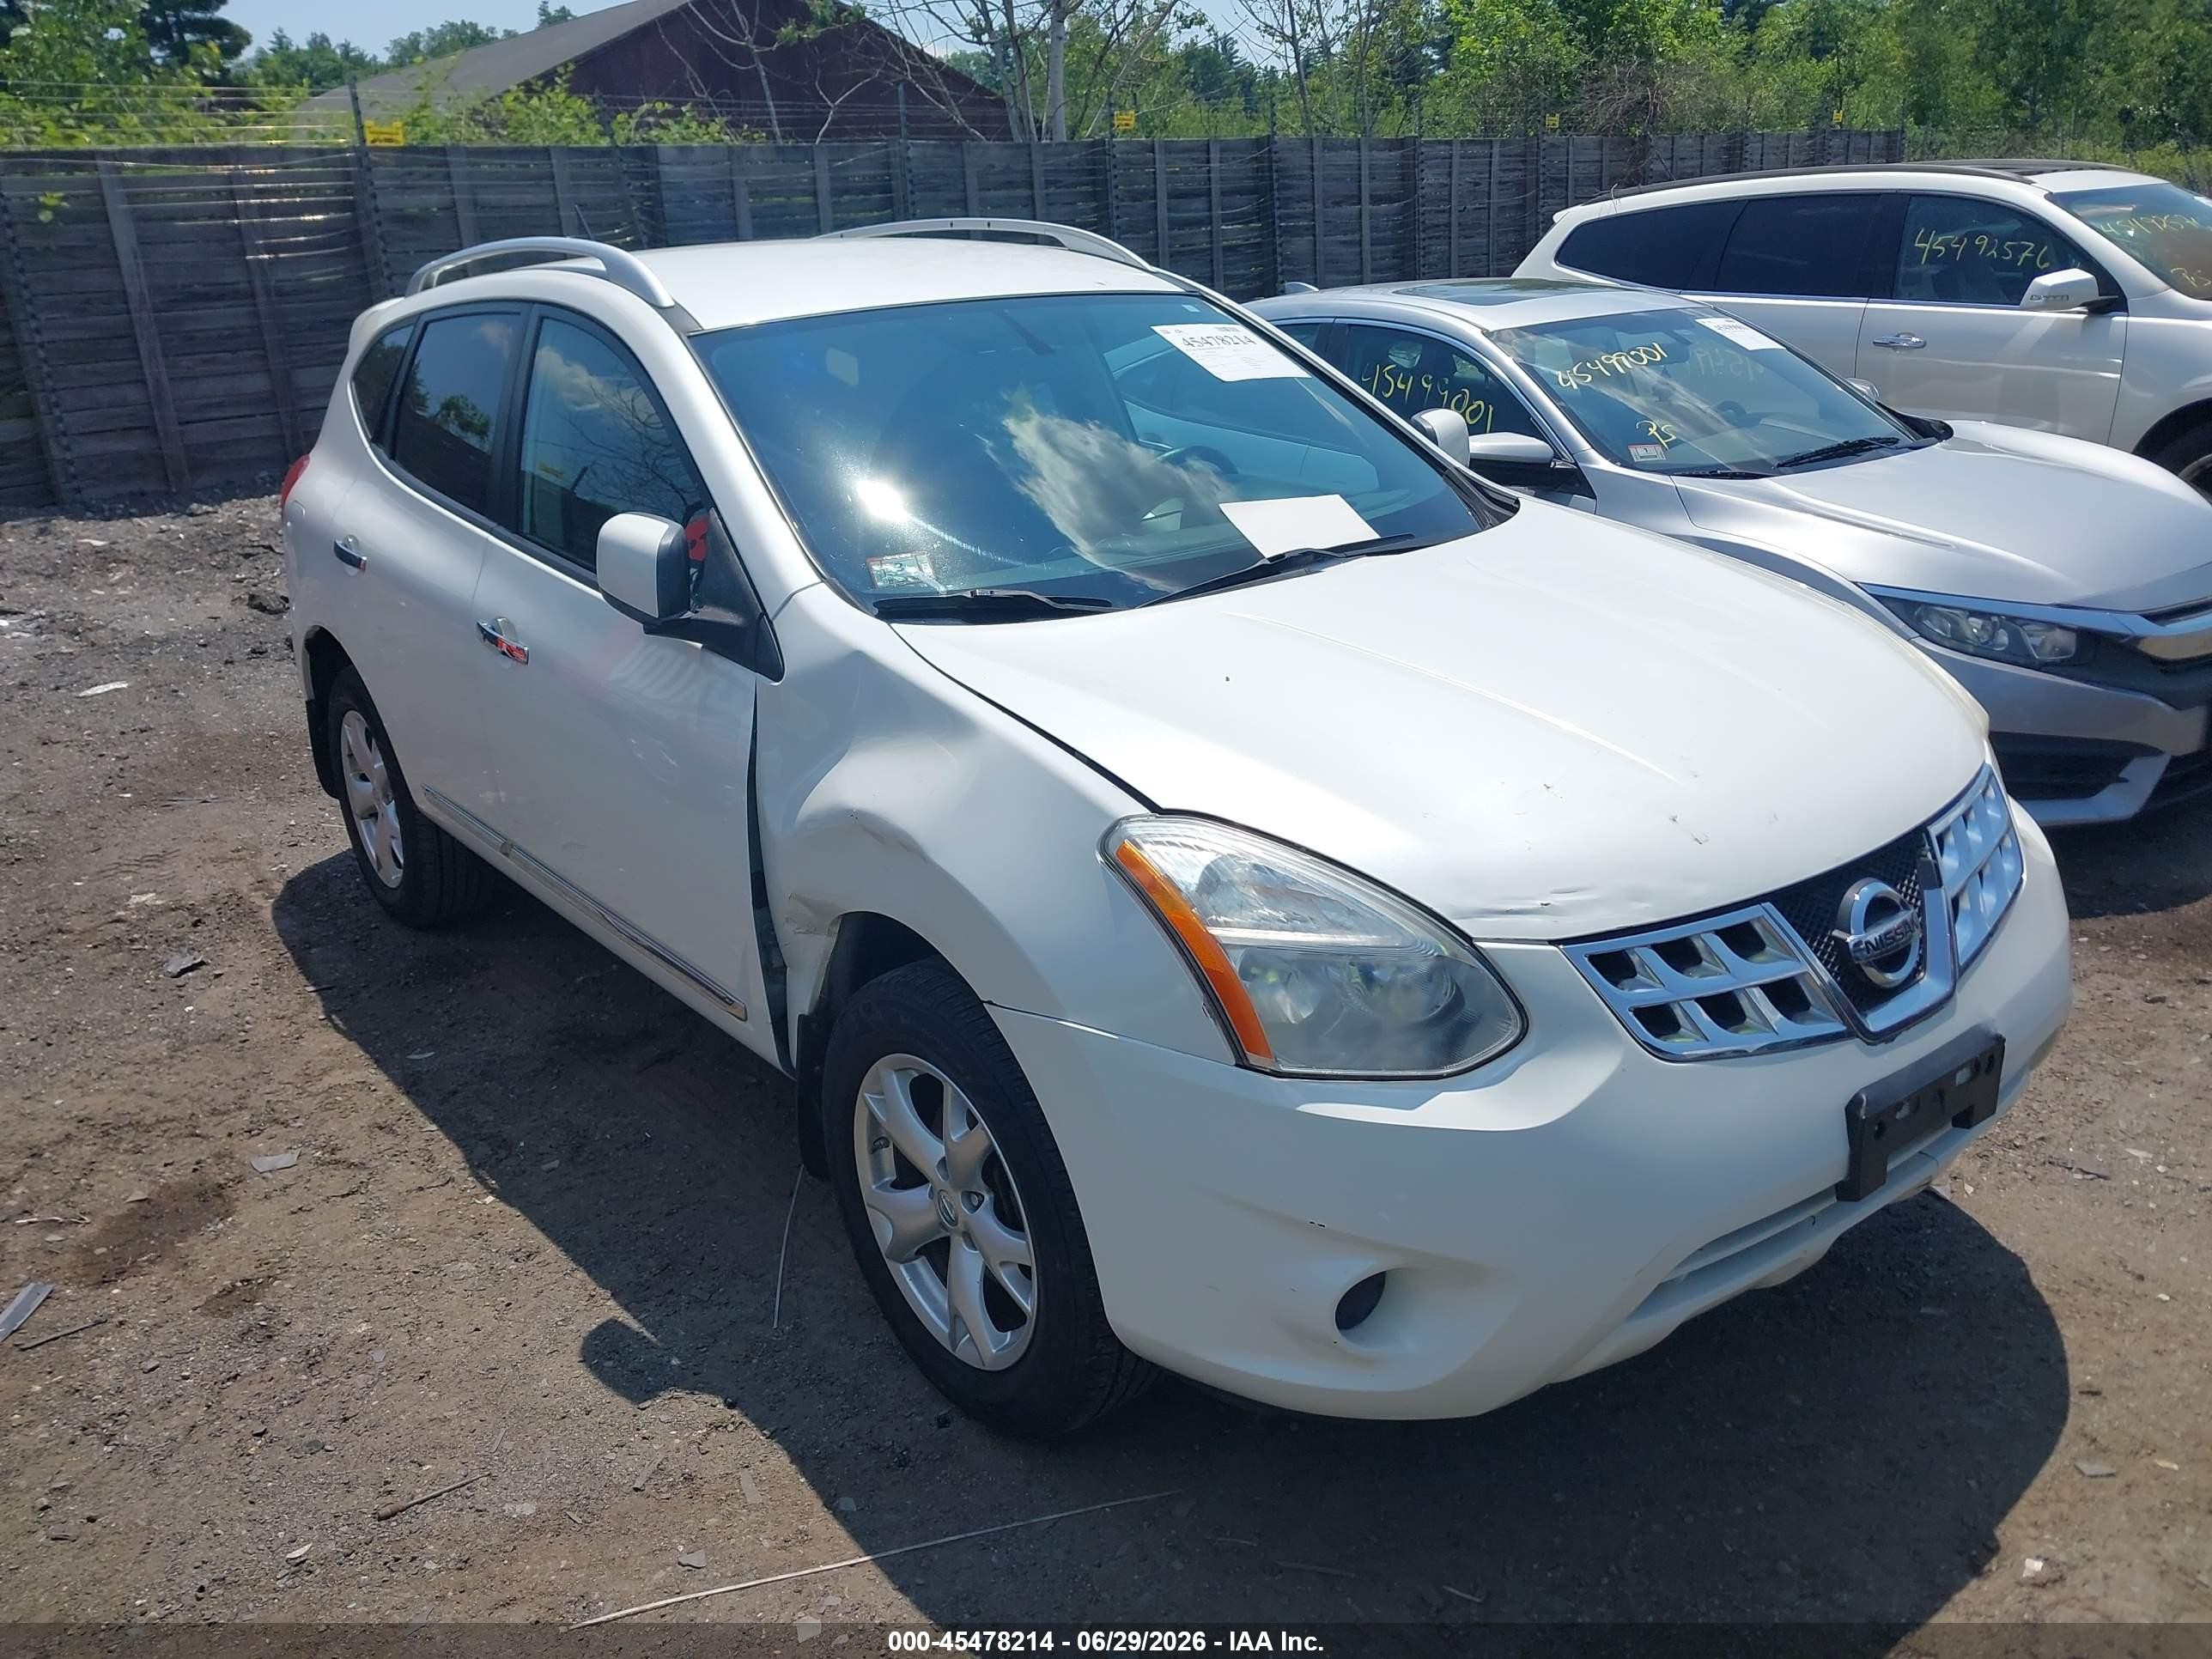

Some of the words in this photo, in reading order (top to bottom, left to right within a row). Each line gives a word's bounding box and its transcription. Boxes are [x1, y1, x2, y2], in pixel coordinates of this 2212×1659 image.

[1914, 228, 2051, 270] 45492576
[1182, 335, 1257, 348] 45478214
[1557, 342, 1668, 390] 45499001
[1361, 363, 1494, 434] 45499001
[1863, 913, 1920, 955] NISSAN
